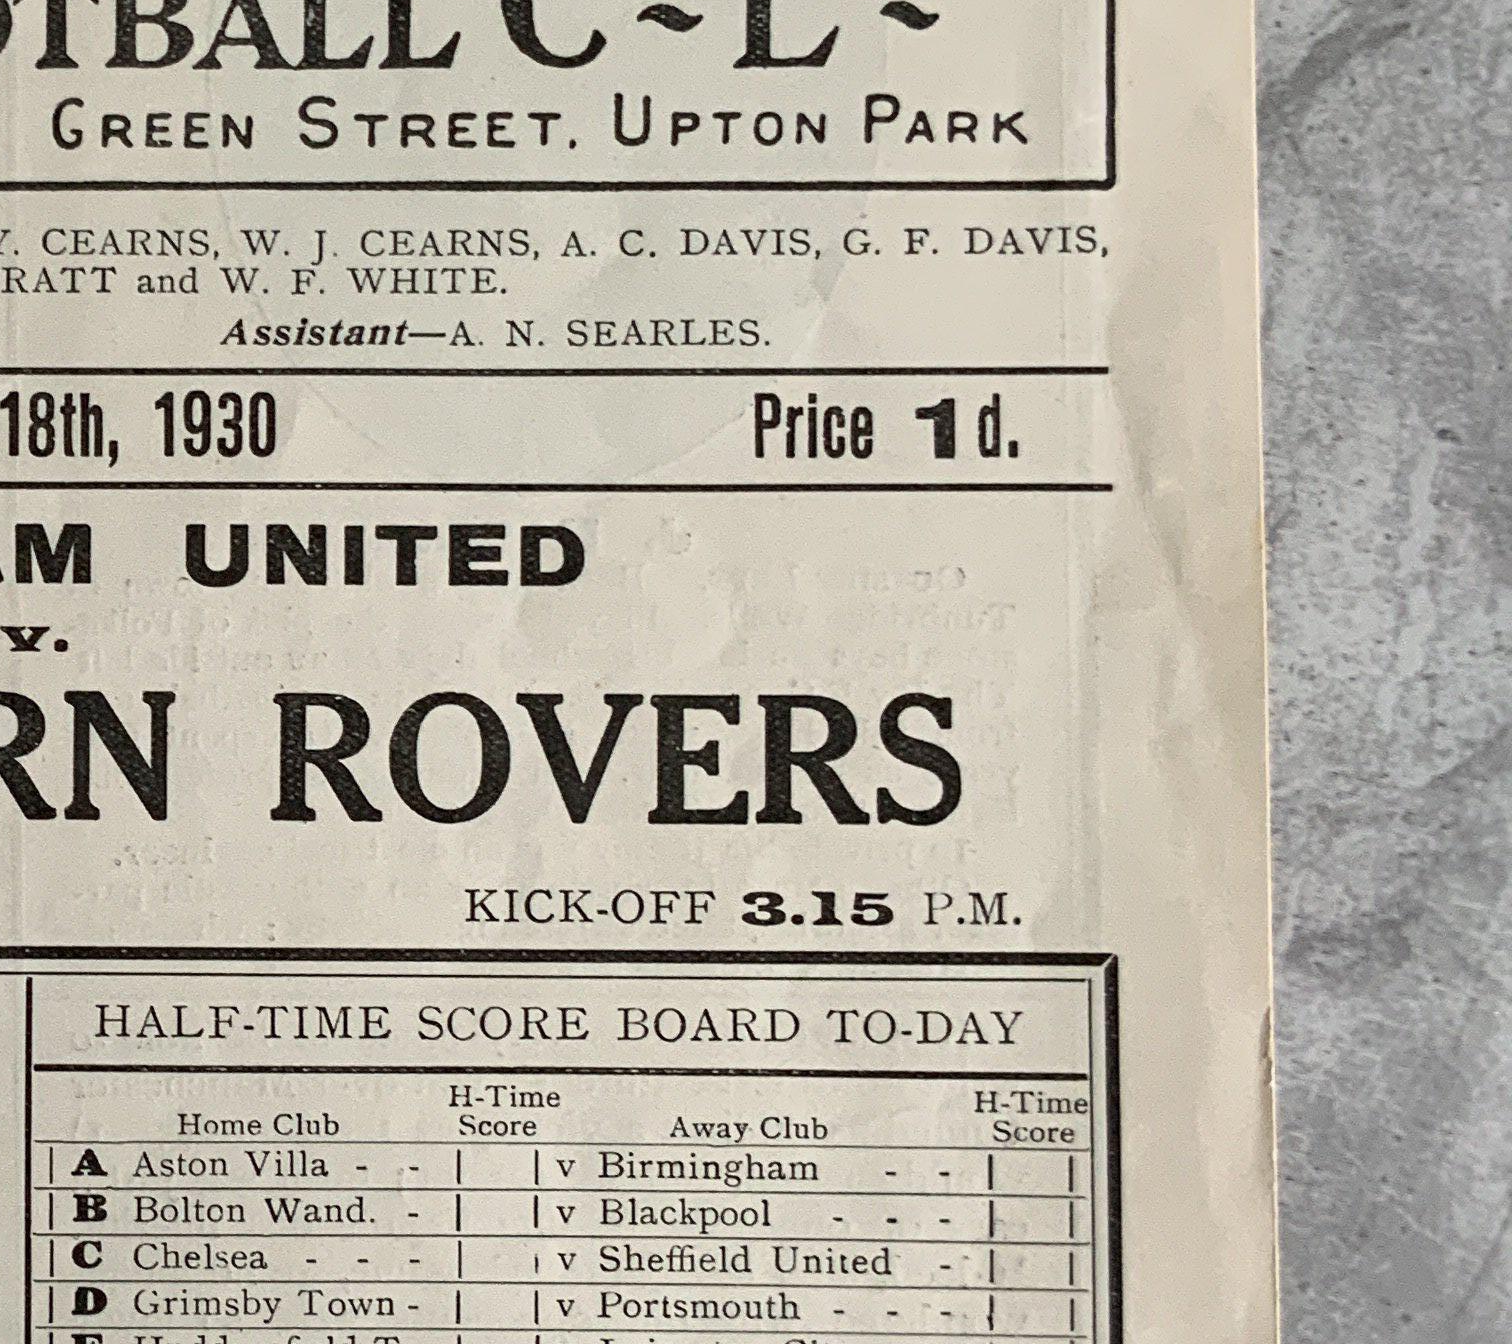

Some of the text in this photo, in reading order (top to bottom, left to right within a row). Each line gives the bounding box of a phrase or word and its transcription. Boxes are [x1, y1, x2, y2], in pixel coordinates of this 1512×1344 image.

[51, 97, 254, 151] GREEN
[613, 92, 827, 147] UPTON
[863, 92, 1028, 145] PARK
[41, 227, 220, 261] CEARNS,
[239, 229, 290, 256] W.
[310, 229, 340, 267] J.
[360, 228, 540, 261] CEARNS,
[560, 230, 596, 258] A.
[619, 229, 656, 258] C.
[679, 227, 821, 261] DAVIS,
[843, 228, 880, 256] G.
[903, 227, 939, 255] F.
[963, 225, 1108, 258] DAVIS,
[137, 266, 199, 294] and
[219, 267, 269, 294] W.
[291, 268, 325, 296] F.
[346, 267, 507, 295] WHITE.
[505, 320, 545, 347] N.
[567, 318, 770, 347] SEARLES.
[154, 389, 277, 458] 1930
[753, 392, 874, 460] Price
[181, 523, 586, 588] UNITED
[0, 625, 69, 653] v.
[269, 691, 963, 827] ROVERS
[464, 888, 1022, 927] KICK-OFF 3.15 P.M.
[94, 1004, 1023, 1045] HALF-TIME SCORE BOARD TO-DAY
[448, 1084, 561, 1108] H-Time
[974, 1090, 1089, 1115] H-Time
[177, 1112, 340, 1136] Home Club
[458, 1114, 537, 1137] Score
[669, 1116, 829, 1144] Away Club
[993, 1120, 1075, 1144] Score
[70, 1148, 819, 1188] A Aston Villa v Birmingham
